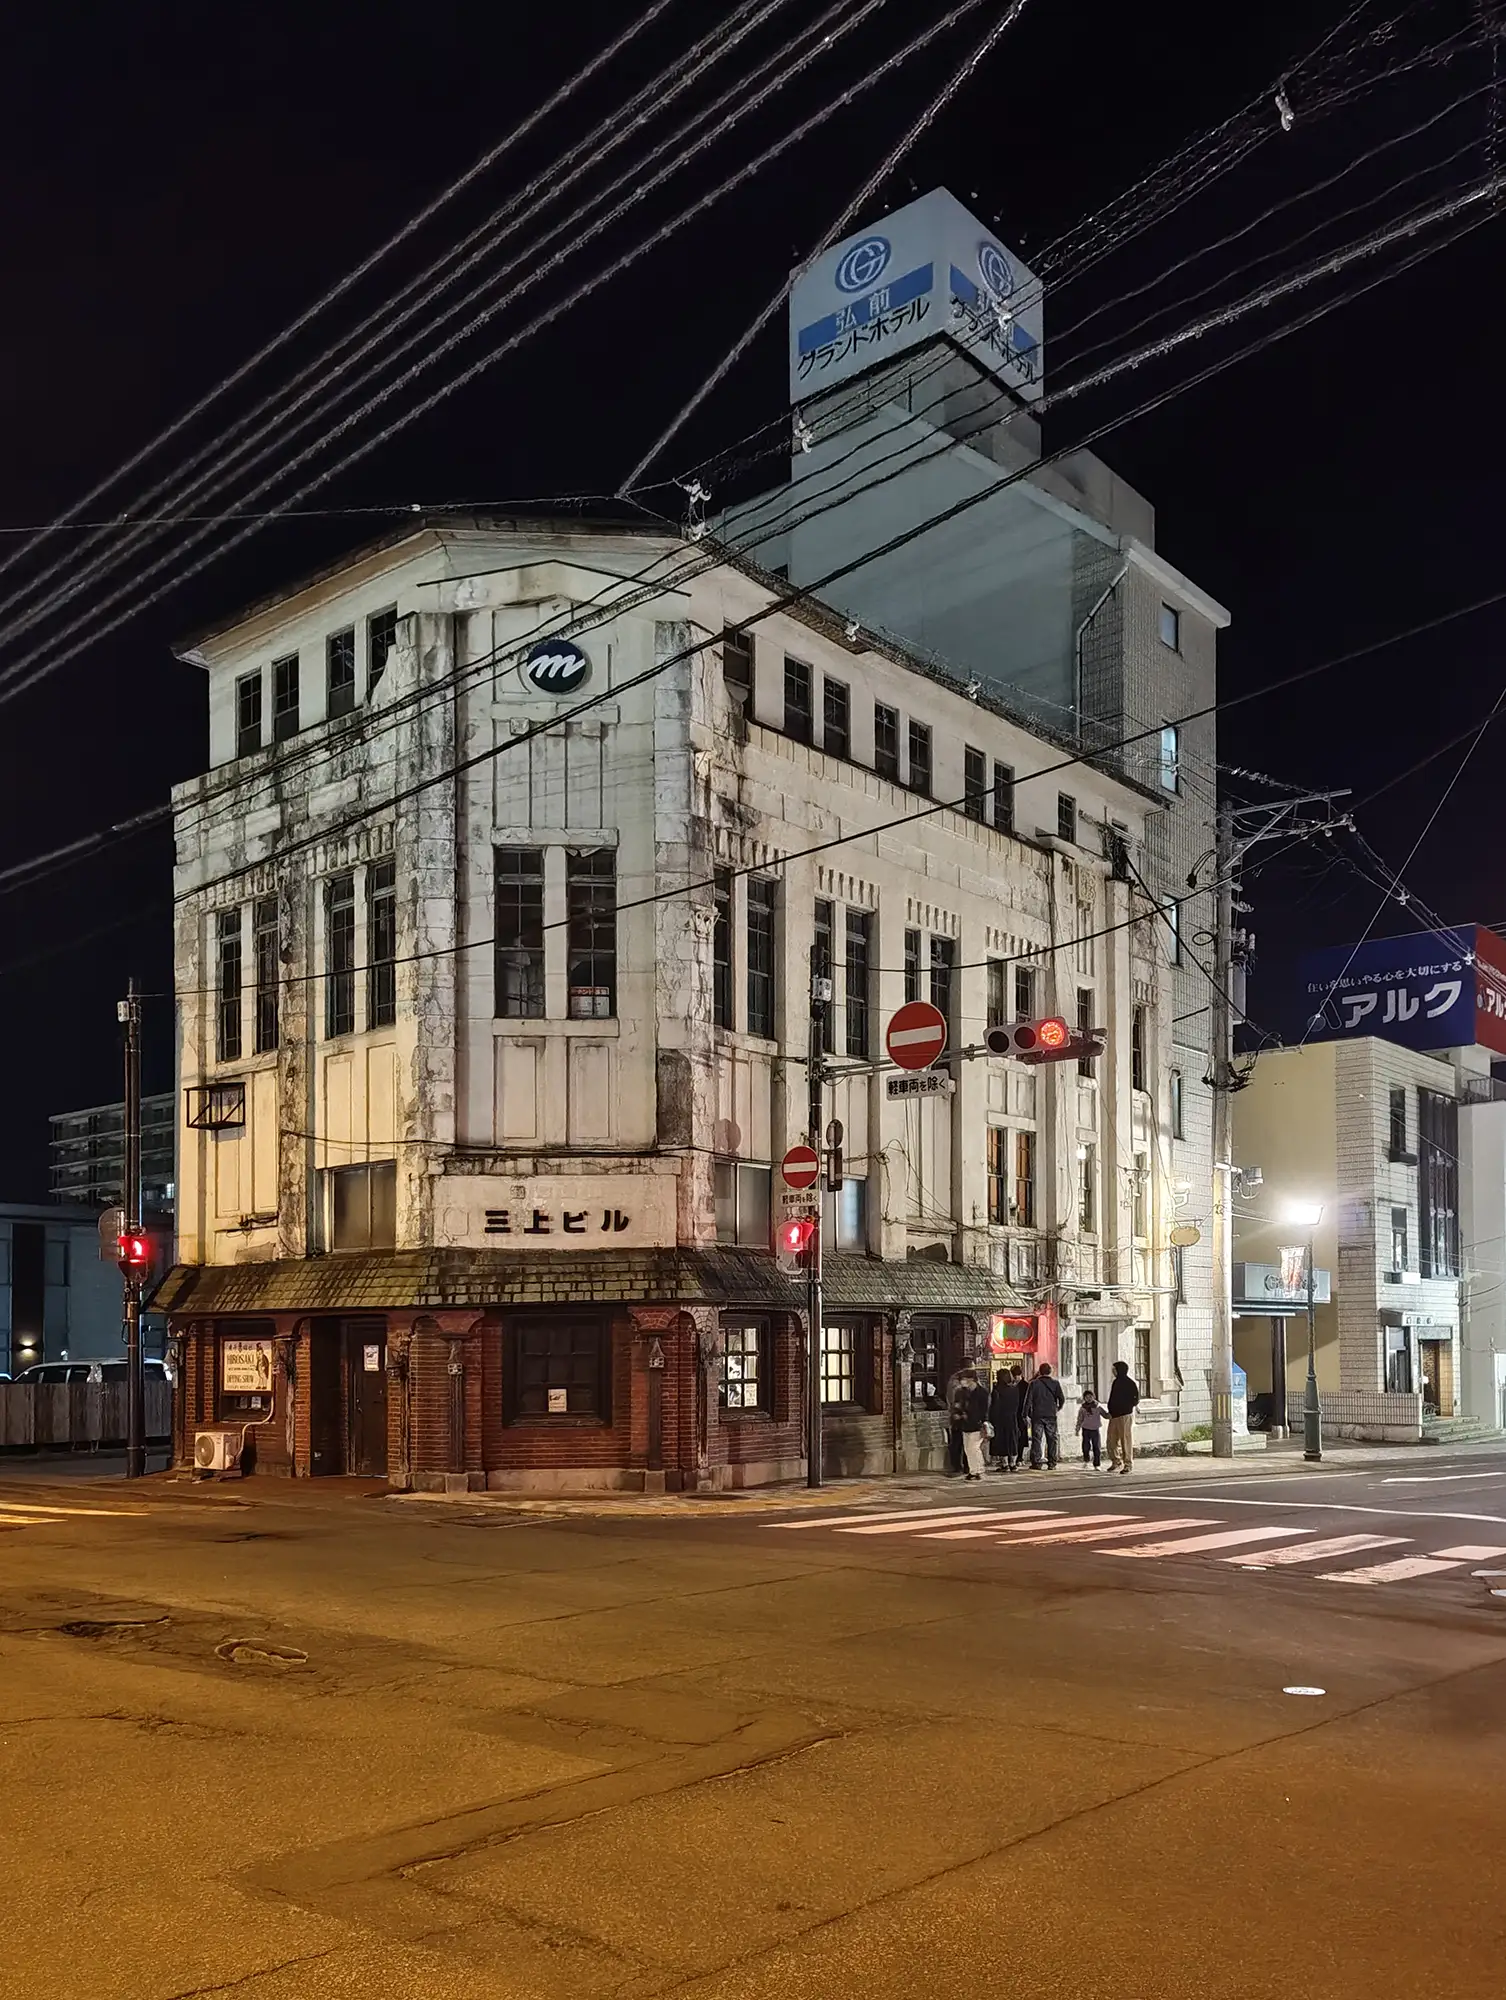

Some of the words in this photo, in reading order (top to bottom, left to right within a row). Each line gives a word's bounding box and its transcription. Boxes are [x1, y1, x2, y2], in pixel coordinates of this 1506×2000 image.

[837, 287, 891, 334] 弘前
[797, 298, 931, 381] グランドホテル
[1307, 961, 1463, 993] 住いを思いやる心を大切にする
[1341, 980, 1462, 1029] アルク
[1486, 987, 1506, 1020] アル
[888, 1076, 947, 1095] 軽車両を除く
[484, 1209, 630, 1235] 三上ビル
